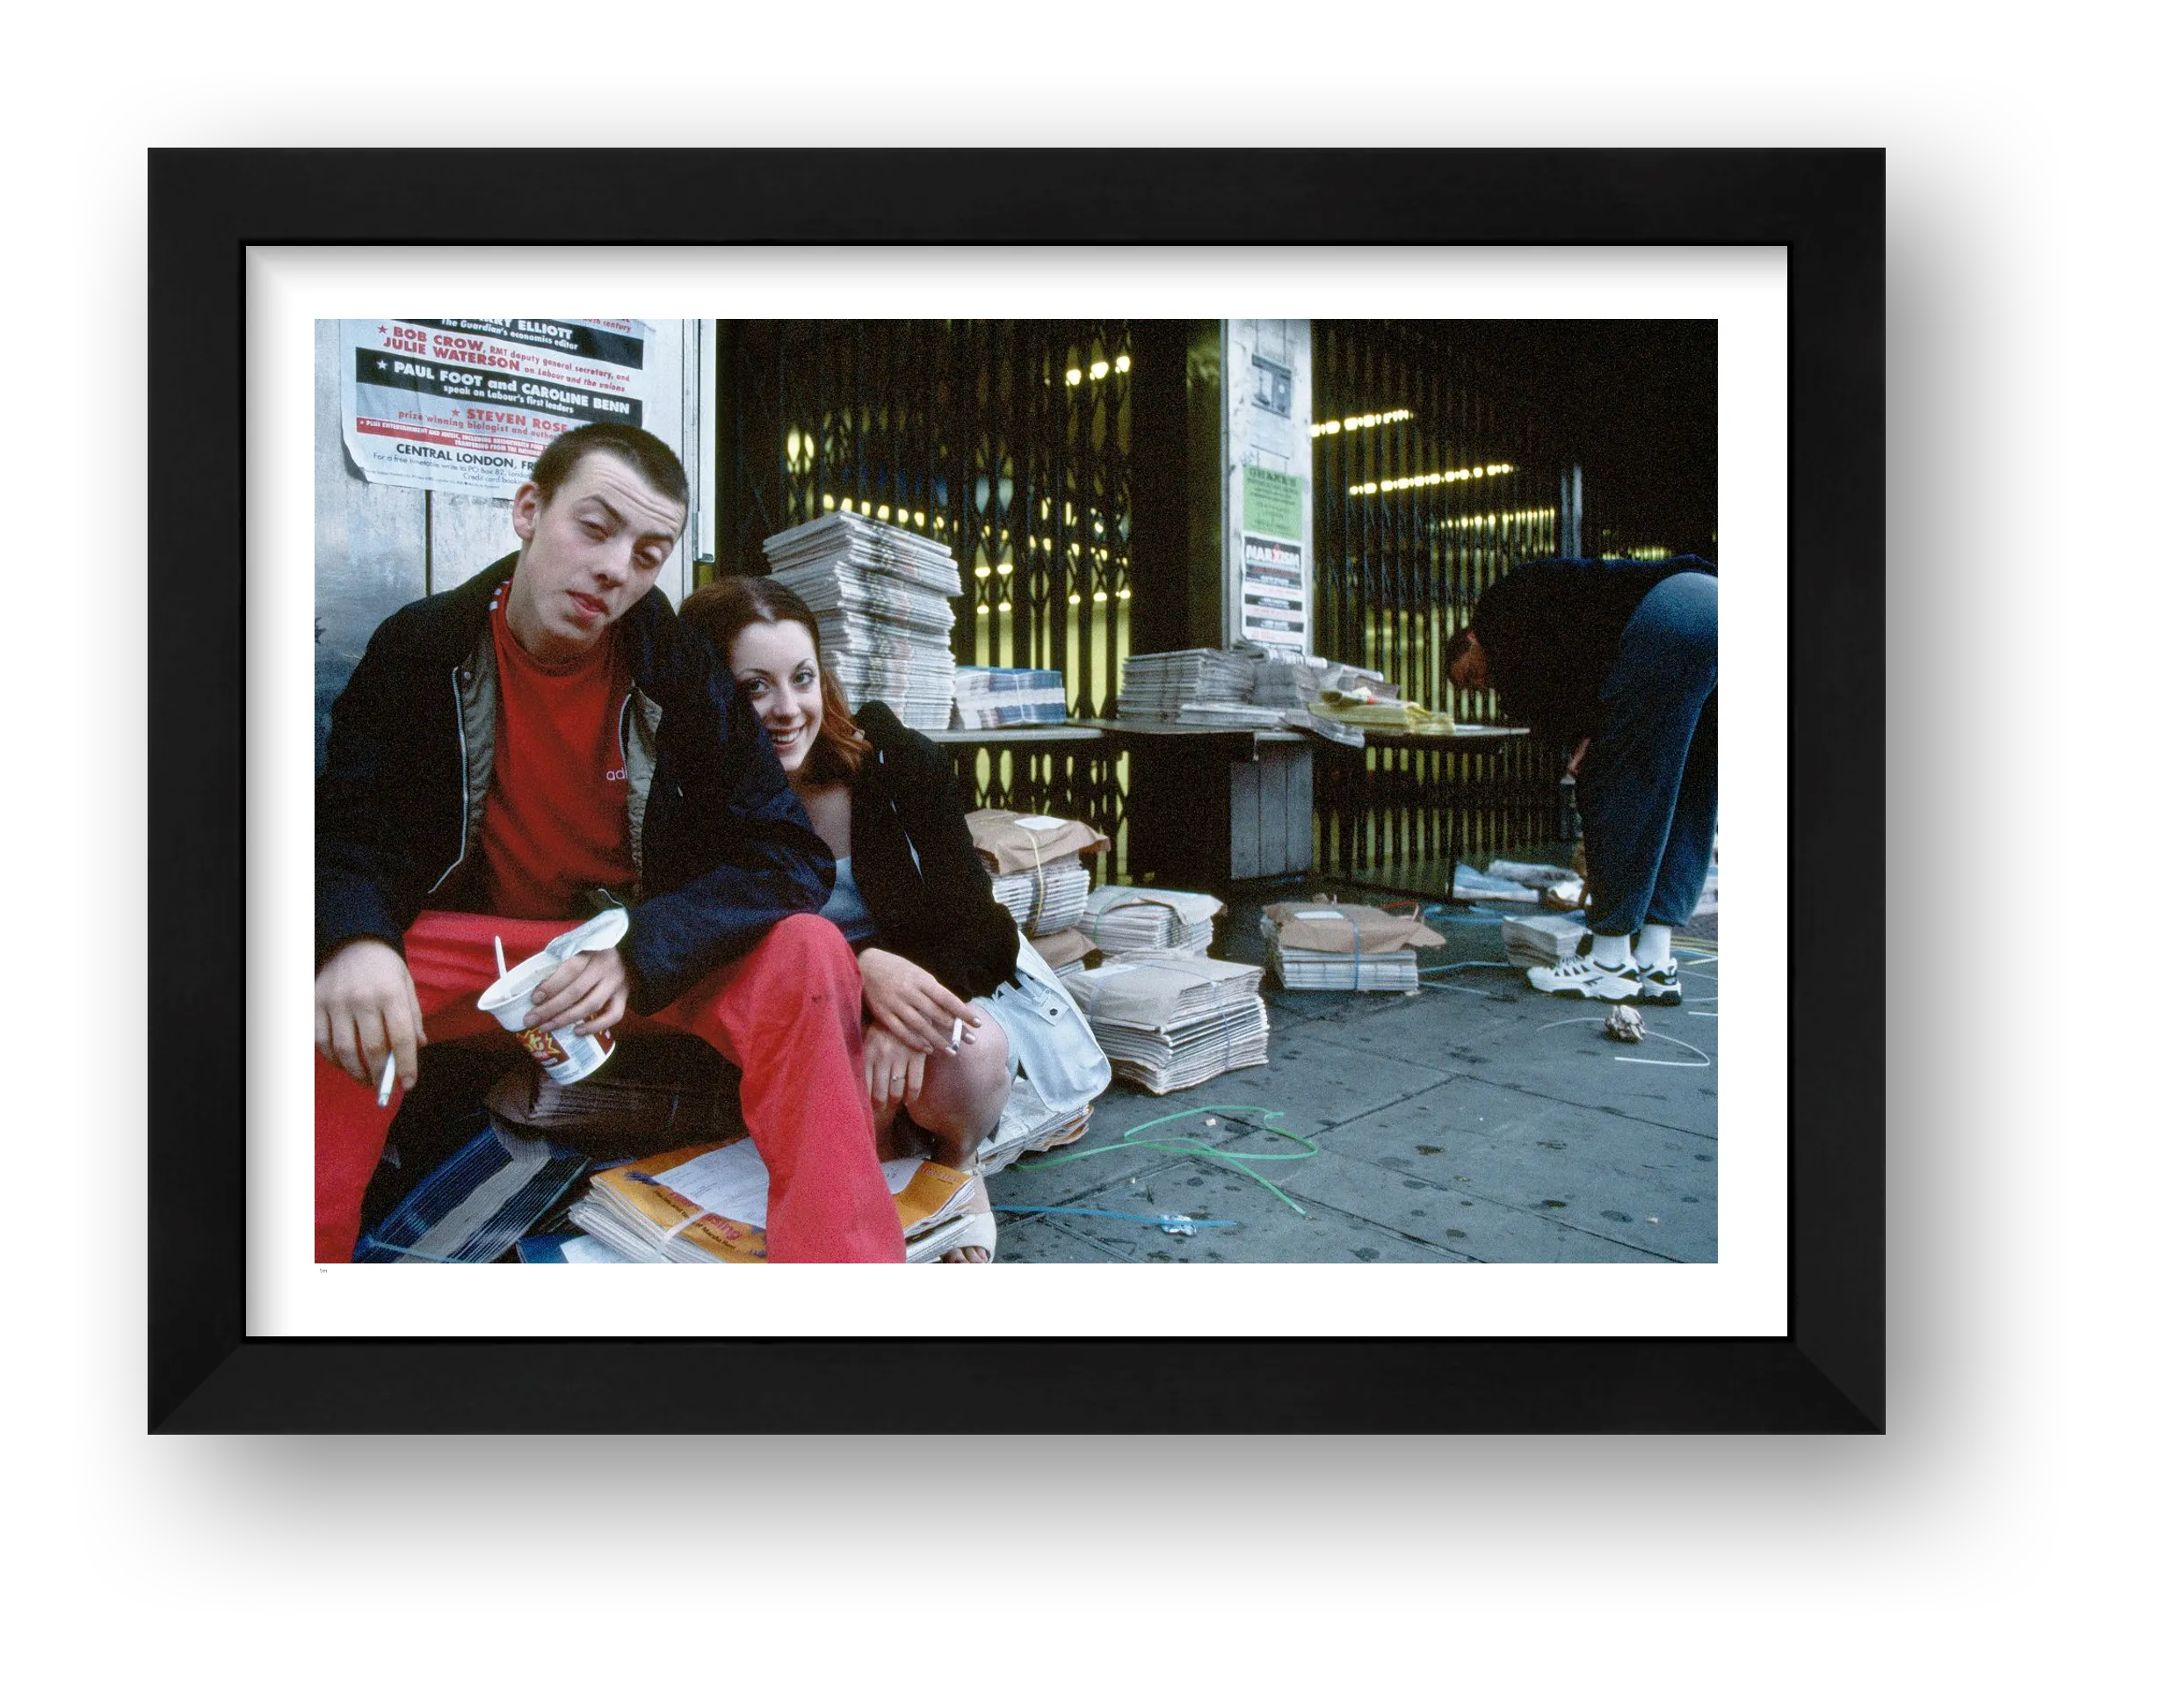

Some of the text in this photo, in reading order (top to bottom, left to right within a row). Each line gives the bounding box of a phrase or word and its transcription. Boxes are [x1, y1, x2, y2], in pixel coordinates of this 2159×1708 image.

[460, 320, 508, 336] Guardian's
[511, 331, 553, 344] economics
[554, 338, 578, 351] editor
[518, 320, 573, 339] ELLIOTT
[604, 321, 631, 333] century
[383, 337, 426, 355] JULIE
[433, 346, 519, 372] WATERSON
[538, 366, 564, 380] Labour
[566, 375, 581, 385] and
[599, 381, 625, 393] unions
[394, 326, 630, 382] BOB CROW, RMT deputy general secretary, and
[394, 361, 630, 414] PAUL FOOT and CAROLINE BENN
[443, 385, 471, 396] speak
[488, 389, 525, 402] Labour's
[527, 397, 543, 407] first
[546, 402, 574, 414] leaders
[398, 409, 423, 421] prize
[426, 415, 464, 429] winning
[467, 421, 508, 433] biologist
[467, 408, 568, 432] STEVEN ROSE
[396, 443, 535, 471] CENTRAL LONDON, FR
[463, 473, 483, 481] Credit
